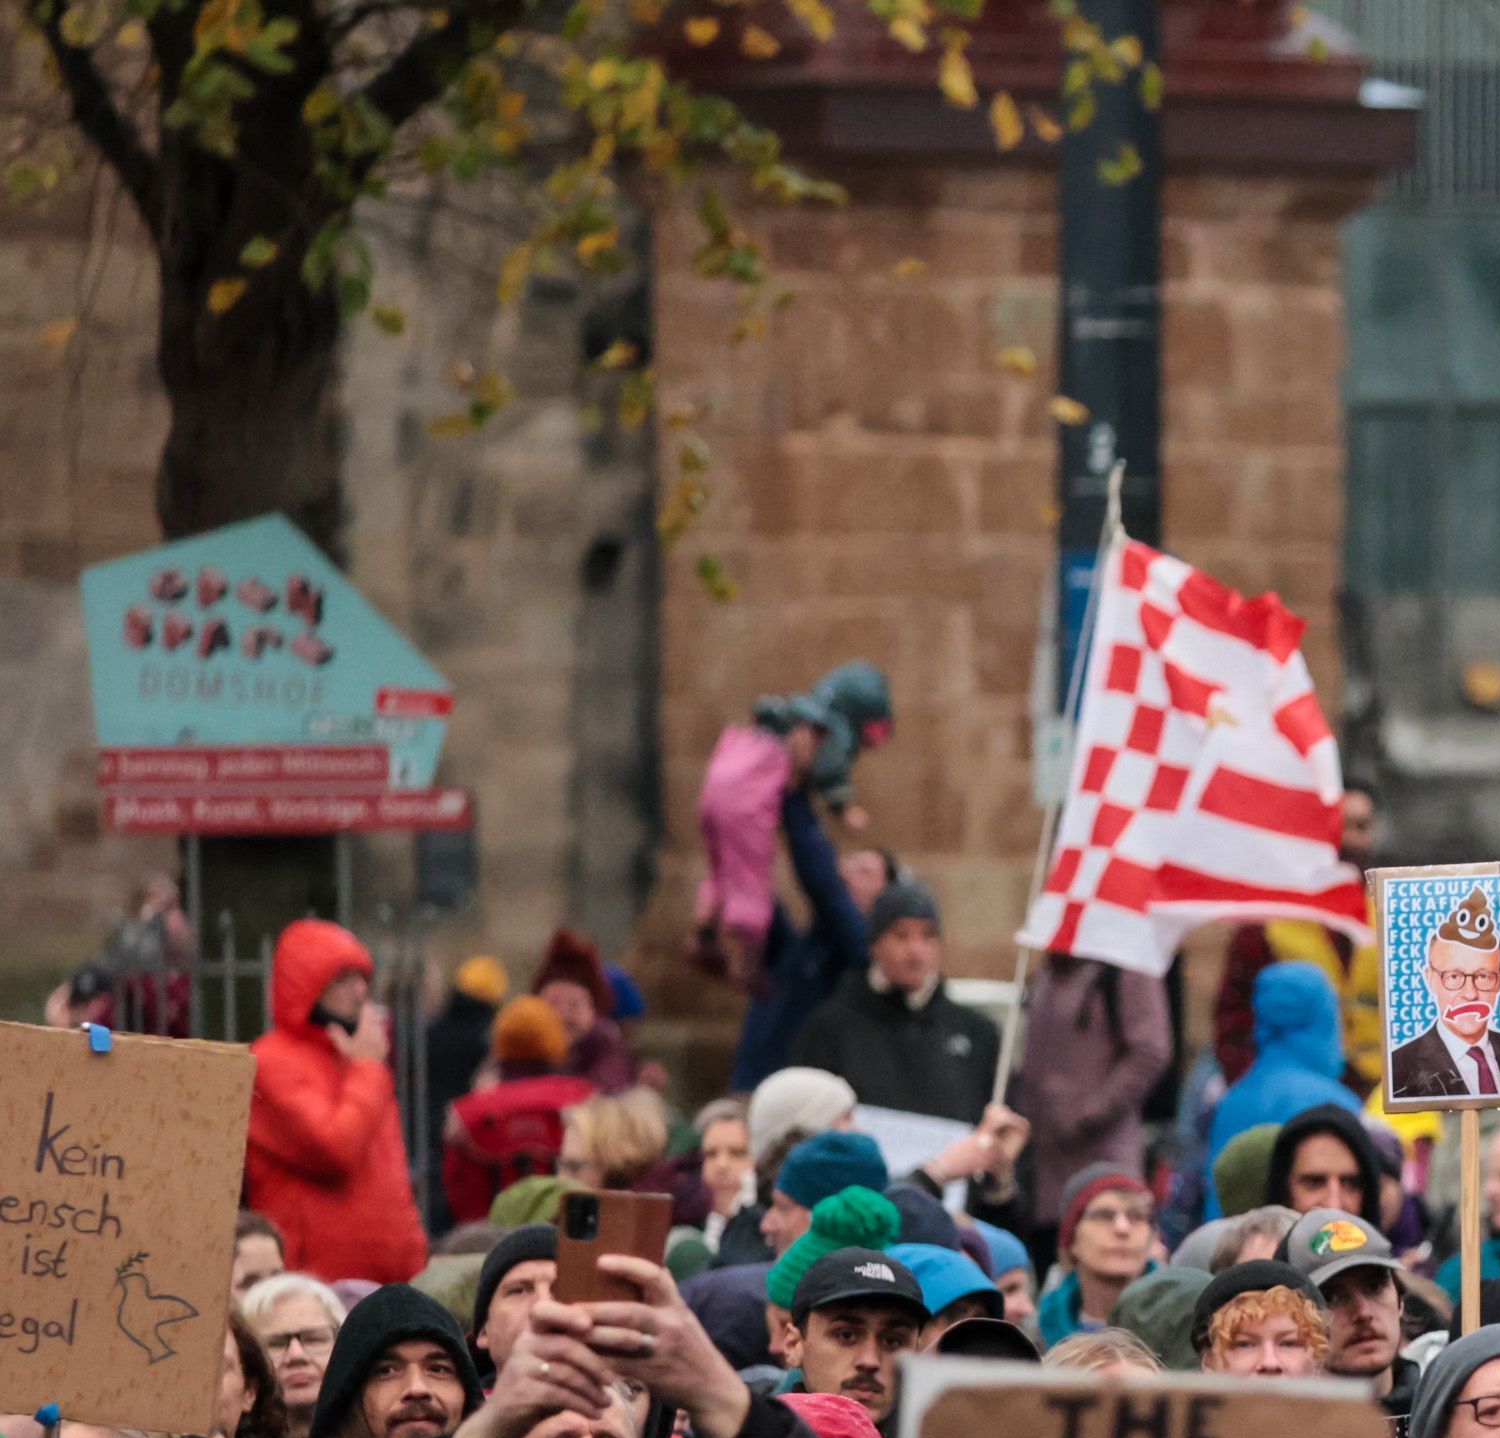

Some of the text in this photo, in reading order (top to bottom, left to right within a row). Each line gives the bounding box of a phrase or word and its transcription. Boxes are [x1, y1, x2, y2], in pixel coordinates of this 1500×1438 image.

[138, 663, 325, 709] DOMSHOF
[34, 1090, 125, 1180] Kein
[22, 1232, 69, 1279] ist
